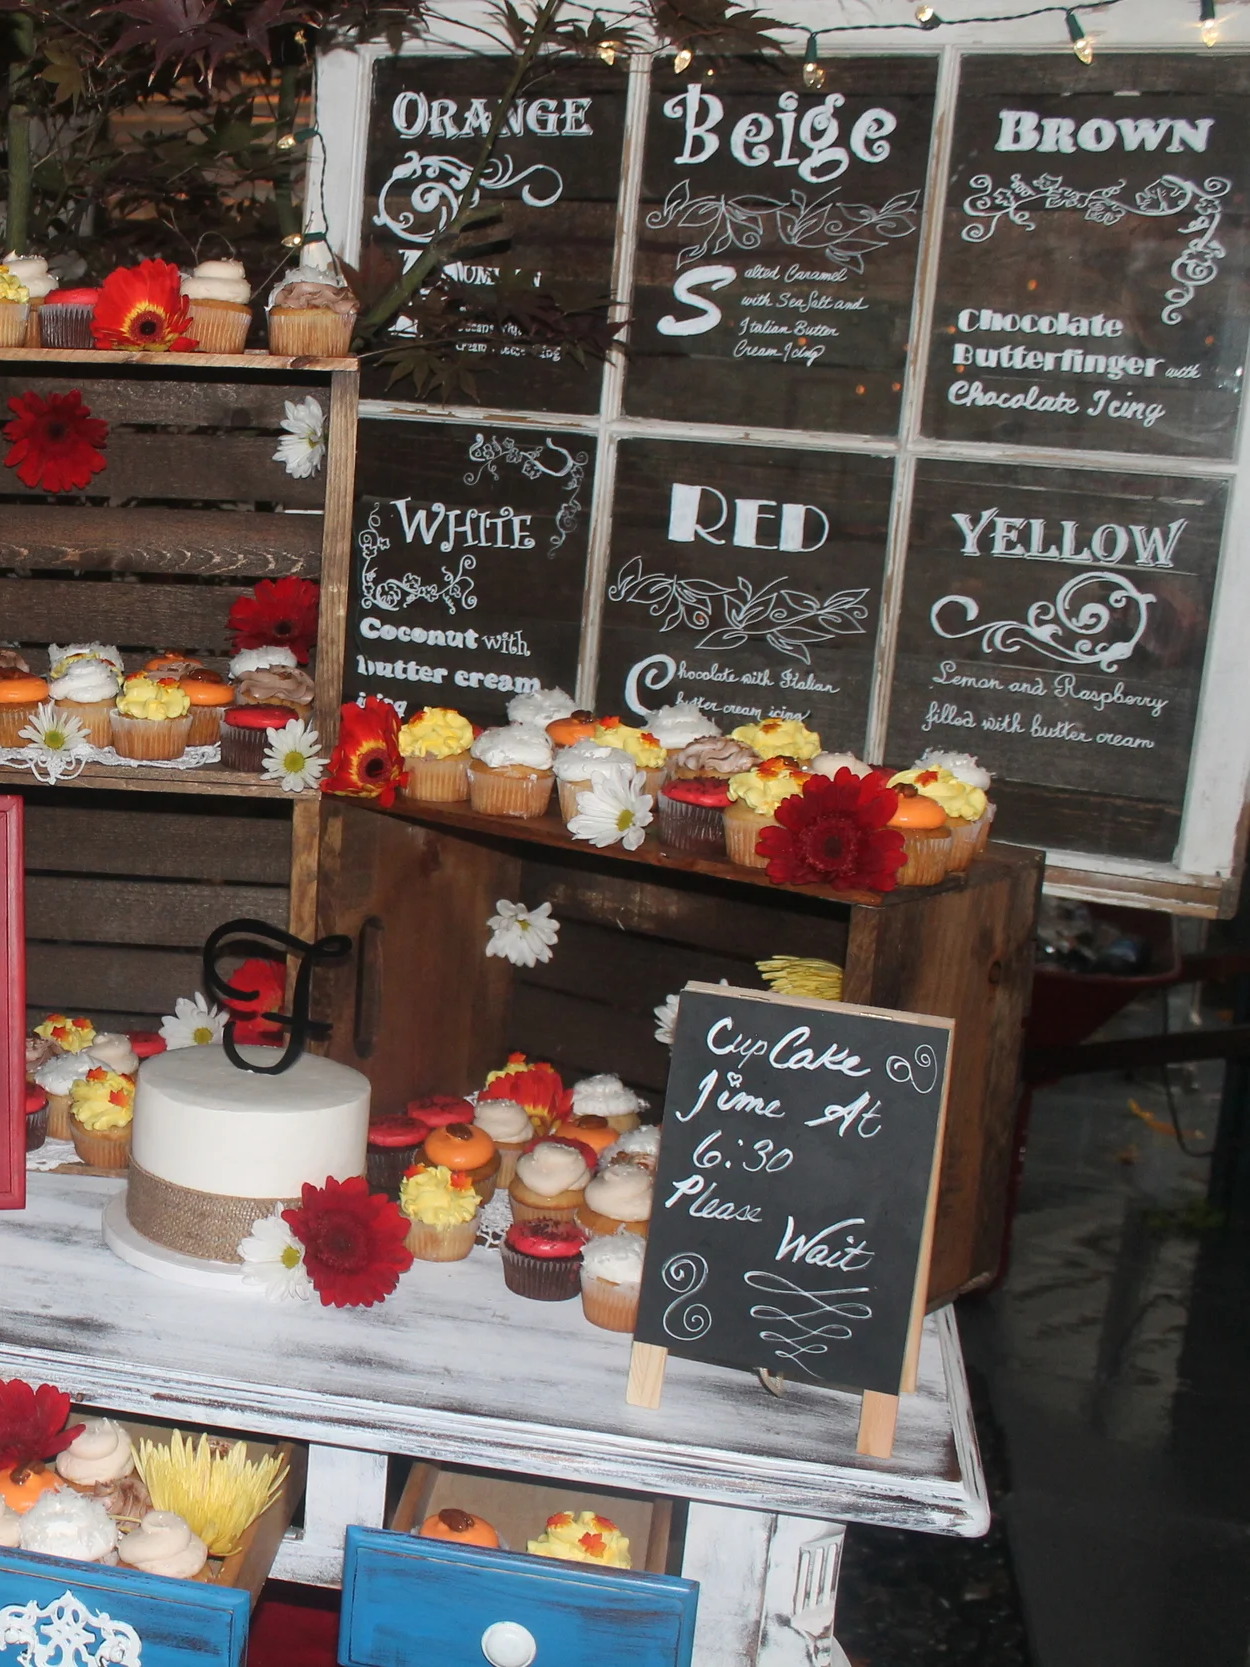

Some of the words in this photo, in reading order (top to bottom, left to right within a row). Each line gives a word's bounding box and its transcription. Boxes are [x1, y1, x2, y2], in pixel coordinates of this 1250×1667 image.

[392, 91, 594, 140] ORANGE
[663, 83, 897, 183] Beige
[993, 108, 1215, 153] BROWN
[784, 263, 848, 283] Caramel
[741, 293, 773, 308] with
[776, 292, 803, 309] Sea
[799, 290, 834, 313] Salt
[833, 297, 869, 311] and
[957, 308, 1124, 338] Chocolate
[738, 317, 792, 336] Italian
[793, 320, 839, 337] Butter
[733, 339, 782, 358] Cream
[781, 341, 825, 366] Icing
[952, 343, 1165, 380] Butterfinger
[1165, 363, 1201, 379] with
[947, 380, 1080, 415] Chocolate
[1086, 389, 1165, 427] Icing
[390, 497, 536, 552] WHITE
[668, 483, 829, 552] RED
[952, 507, 1190, 567] YELLOW
[359, 617, 480, 649] Coconut
[482, 630, 531, 657] with
[356, 655, 449, 684] butter
[454, 669, 541, 694] cream
[740, 670, 775, 687] with
[779, 668, 840, 693] Italian
[932, 660, 1003, 690] Lemon
[1008, 678, 1047, 696] and
[1053, 674, 1168, 717] Raspberry
[723, 704, 762, 722] cream
[922, 701, 976, 731] filled
[981, 713, 1025, 734] with
[1030, 714, 1092, 742] butter
[1096, 733, 1155, 748] cream
[675, 1069, 785, 1123] Time
[804, 1091, 882, 1139] At
[692, 1130, 793, 1173] 6:30
[664, 1174, 763, 1223] Please
[775, 1215, 875, 1271] Wait
